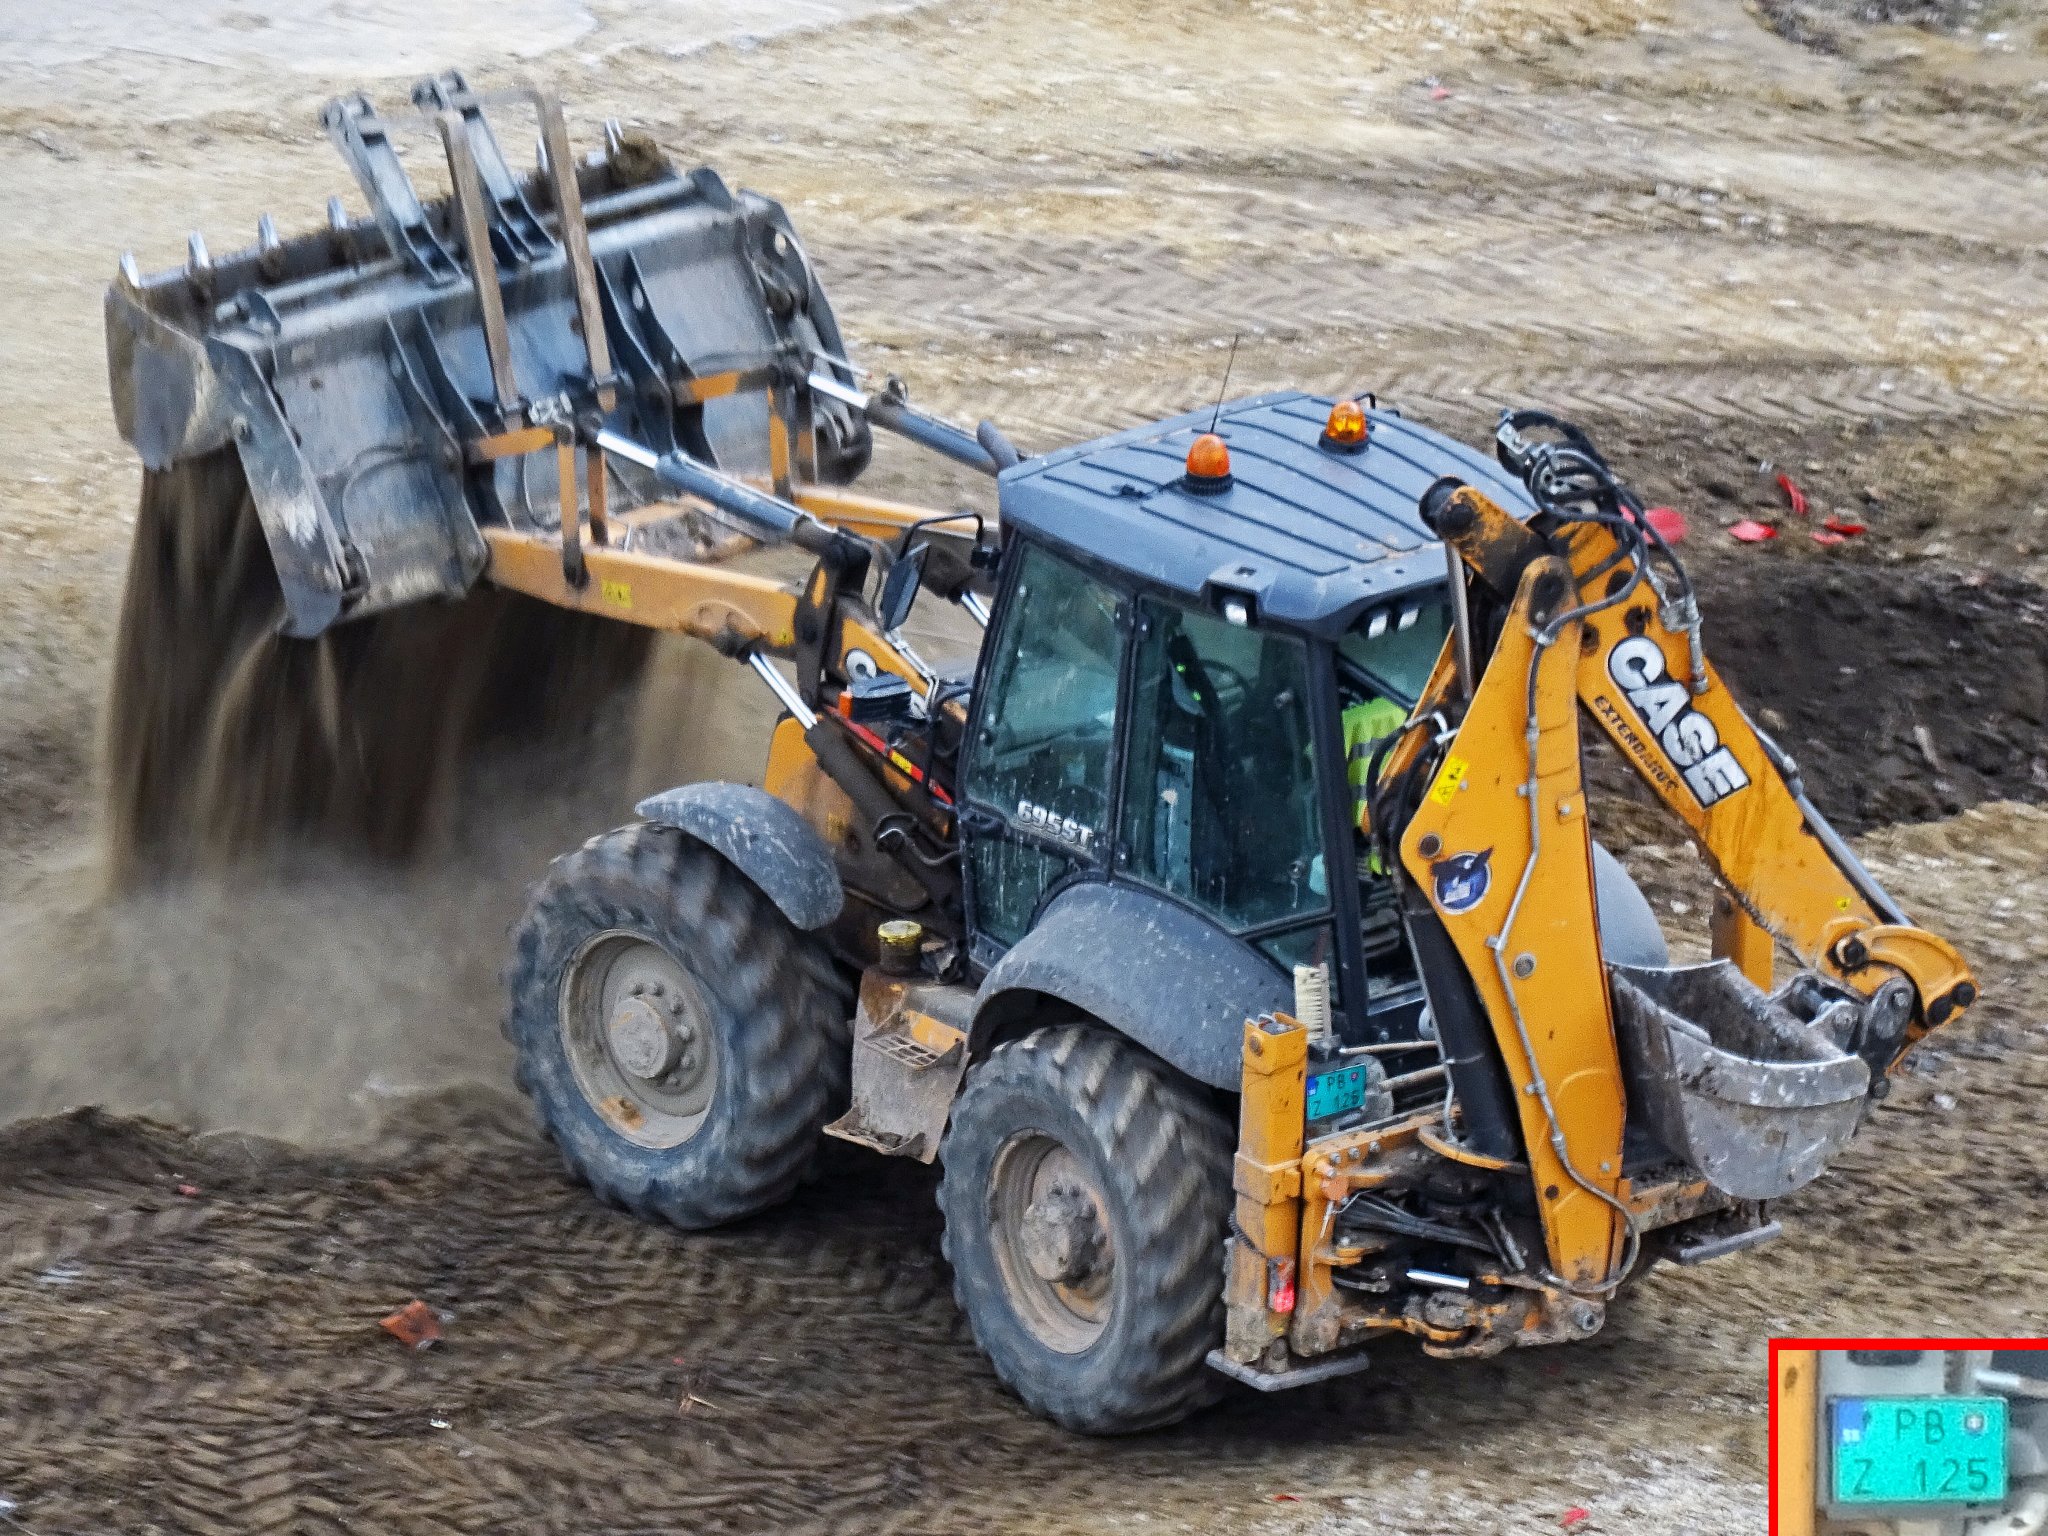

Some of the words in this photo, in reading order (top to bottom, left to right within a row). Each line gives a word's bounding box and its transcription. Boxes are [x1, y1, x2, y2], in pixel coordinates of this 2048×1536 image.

[1608, 636, 1751, 807] CASE
[1017, 800, 1095, 844] 695ST
[1327, 1074, 1345, 1090] PB
[1895, 1409, 1945, 1445] PB
[1853, 1458, 1874, 1495] Z
[1915, 1457, 1988, 1493] 125
